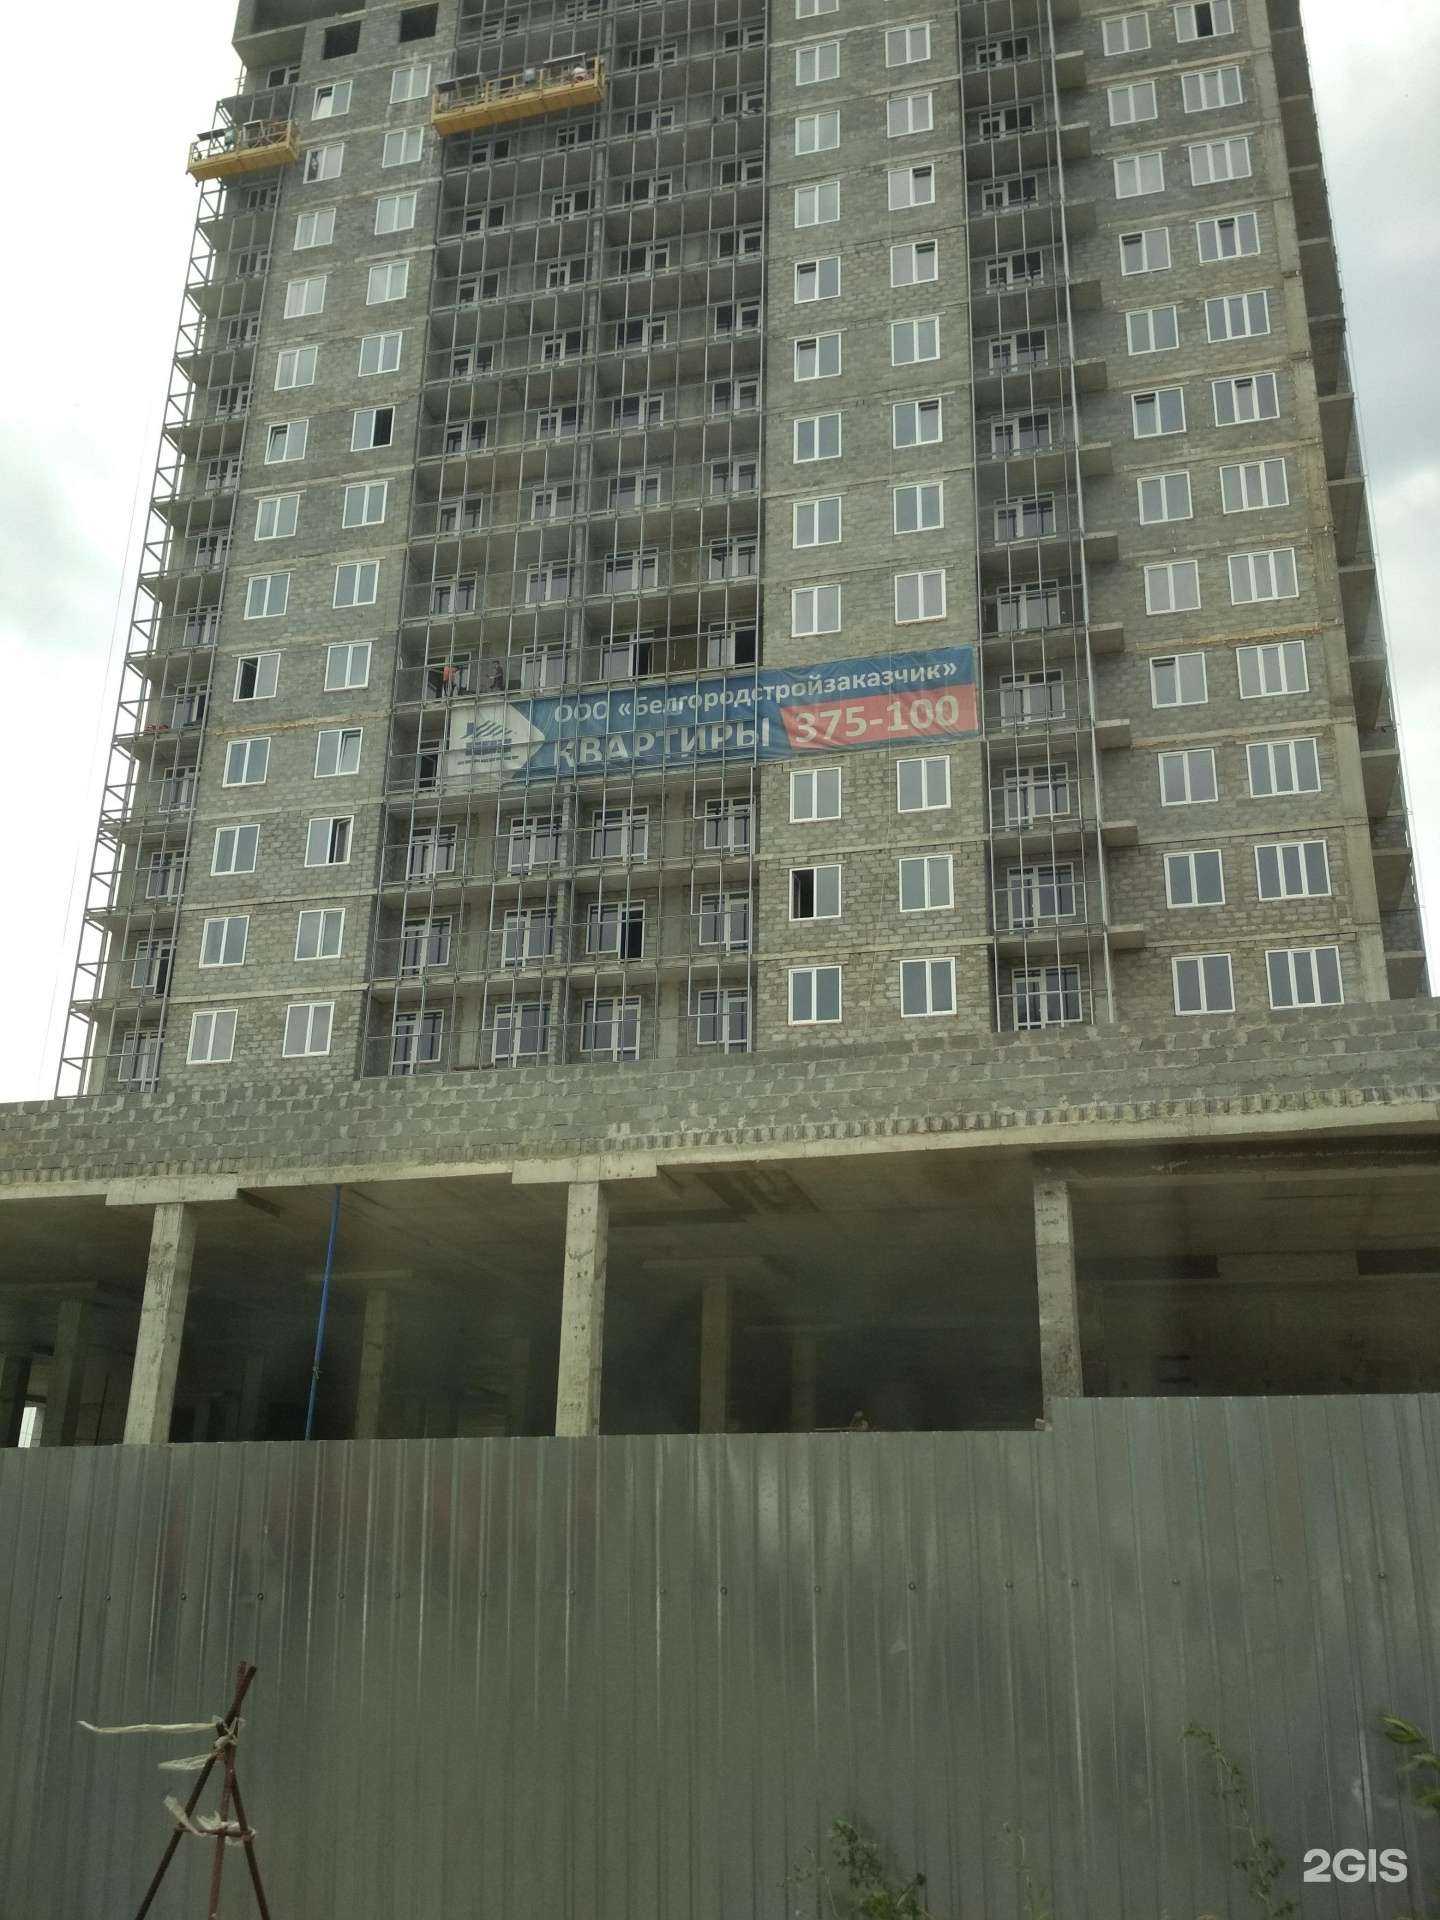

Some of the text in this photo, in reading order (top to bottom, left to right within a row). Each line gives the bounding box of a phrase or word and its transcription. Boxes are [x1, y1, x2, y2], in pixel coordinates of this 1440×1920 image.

[554, 662, 958, 723] ООО «Белгородстройзаказчик»
[553, 717, 770, 768] КВАРТИРЫ
[796, 695, 959, 743] 375-100
